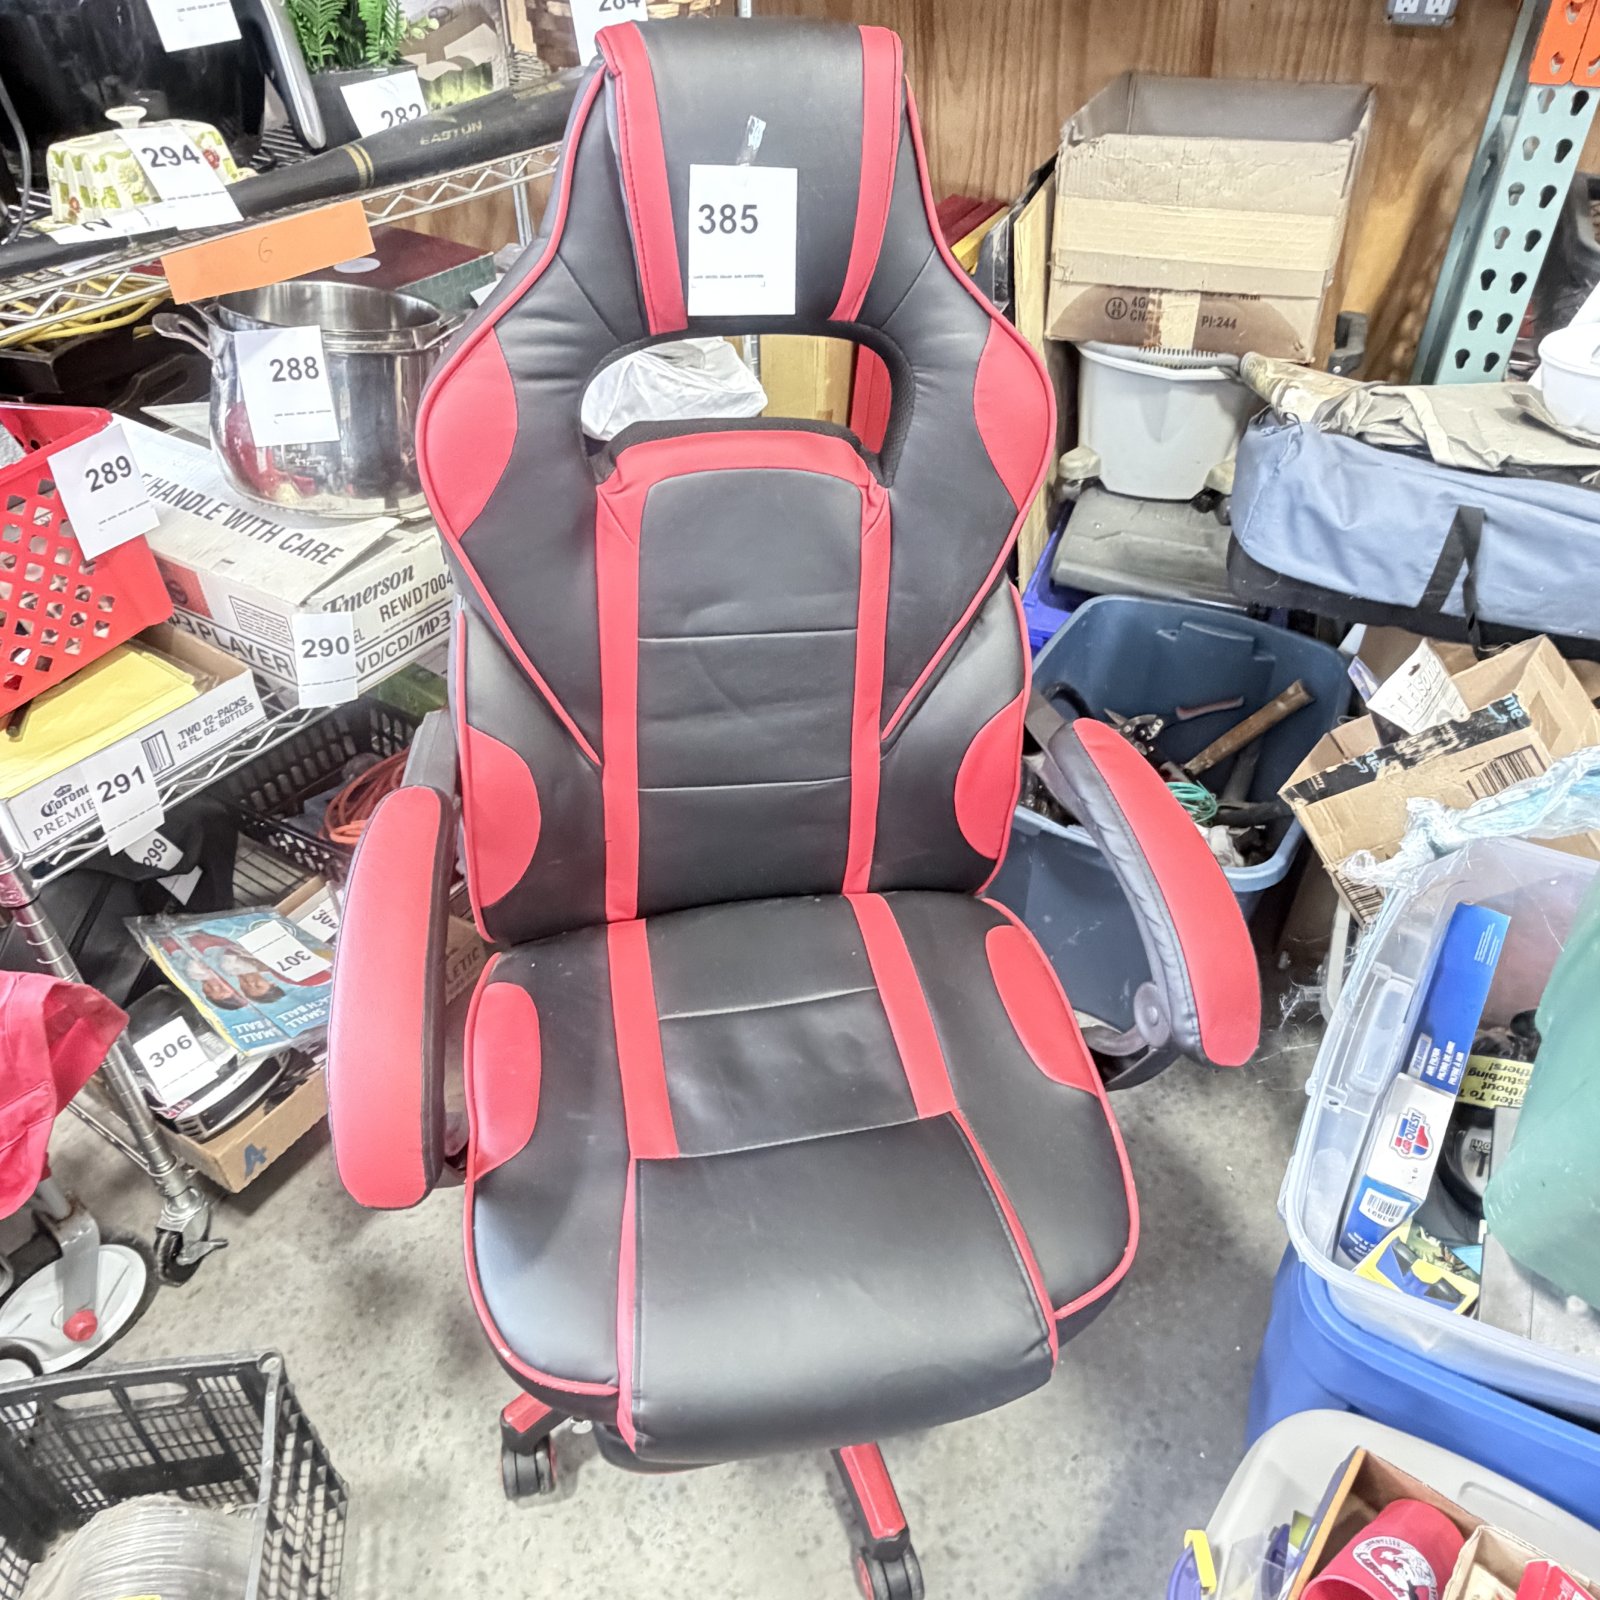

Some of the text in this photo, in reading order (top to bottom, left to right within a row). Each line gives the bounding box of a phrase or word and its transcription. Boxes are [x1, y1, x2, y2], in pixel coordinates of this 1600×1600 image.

[141, 144, 201, 168] 294
[697, 203, 759, 235] 385
[269, 356, 320, 382] 288
[85, 455, 132, 493] 289
[223, 507, 279, 543] WITH
[278, 532, 344, 566] CARE
[322, 564, 415, 613] Emerson
[197, 622, 294, 678] PLAYER
[301, 636, 350, 659] 290
[356, 609, 452, 675] VD/CD/MP3
[176, 740, 189, 752] 12
[219, 703, 255, 727] BOTTLES
[178, 697, 248, 741] TWO 12-PACKS
[97, 765, 146, 804] 291
[32, 798, 96, 841] PREMIE
[275, 950, 312, 972] 307
[149, 1034, 193, 1068] 306
